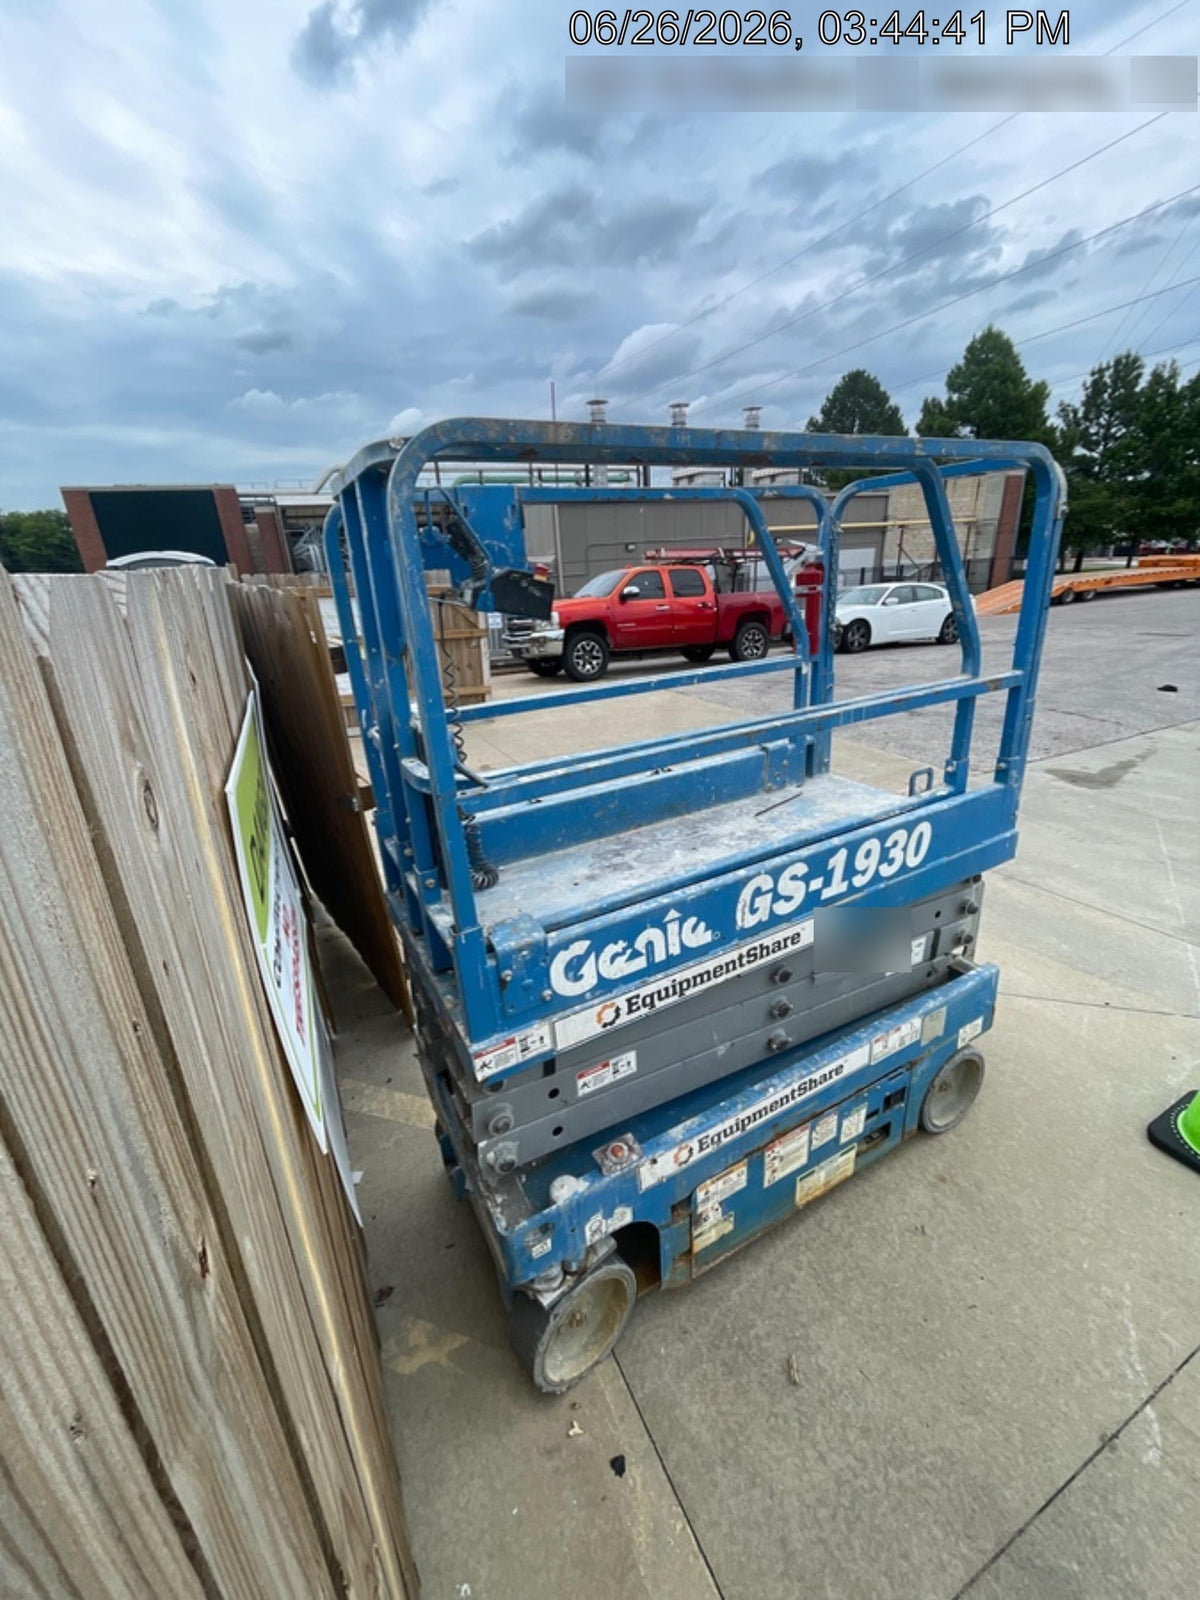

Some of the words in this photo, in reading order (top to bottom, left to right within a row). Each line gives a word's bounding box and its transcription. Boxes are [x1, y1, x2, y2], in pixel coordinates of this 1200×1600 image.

[550, 908, 713, 997] Genie
[735, 821, 932, 931] GS-1930
[625, 931, 801, 1016] EquipmentShare
[697, 1063, 844, 1153] EquipmentShare
